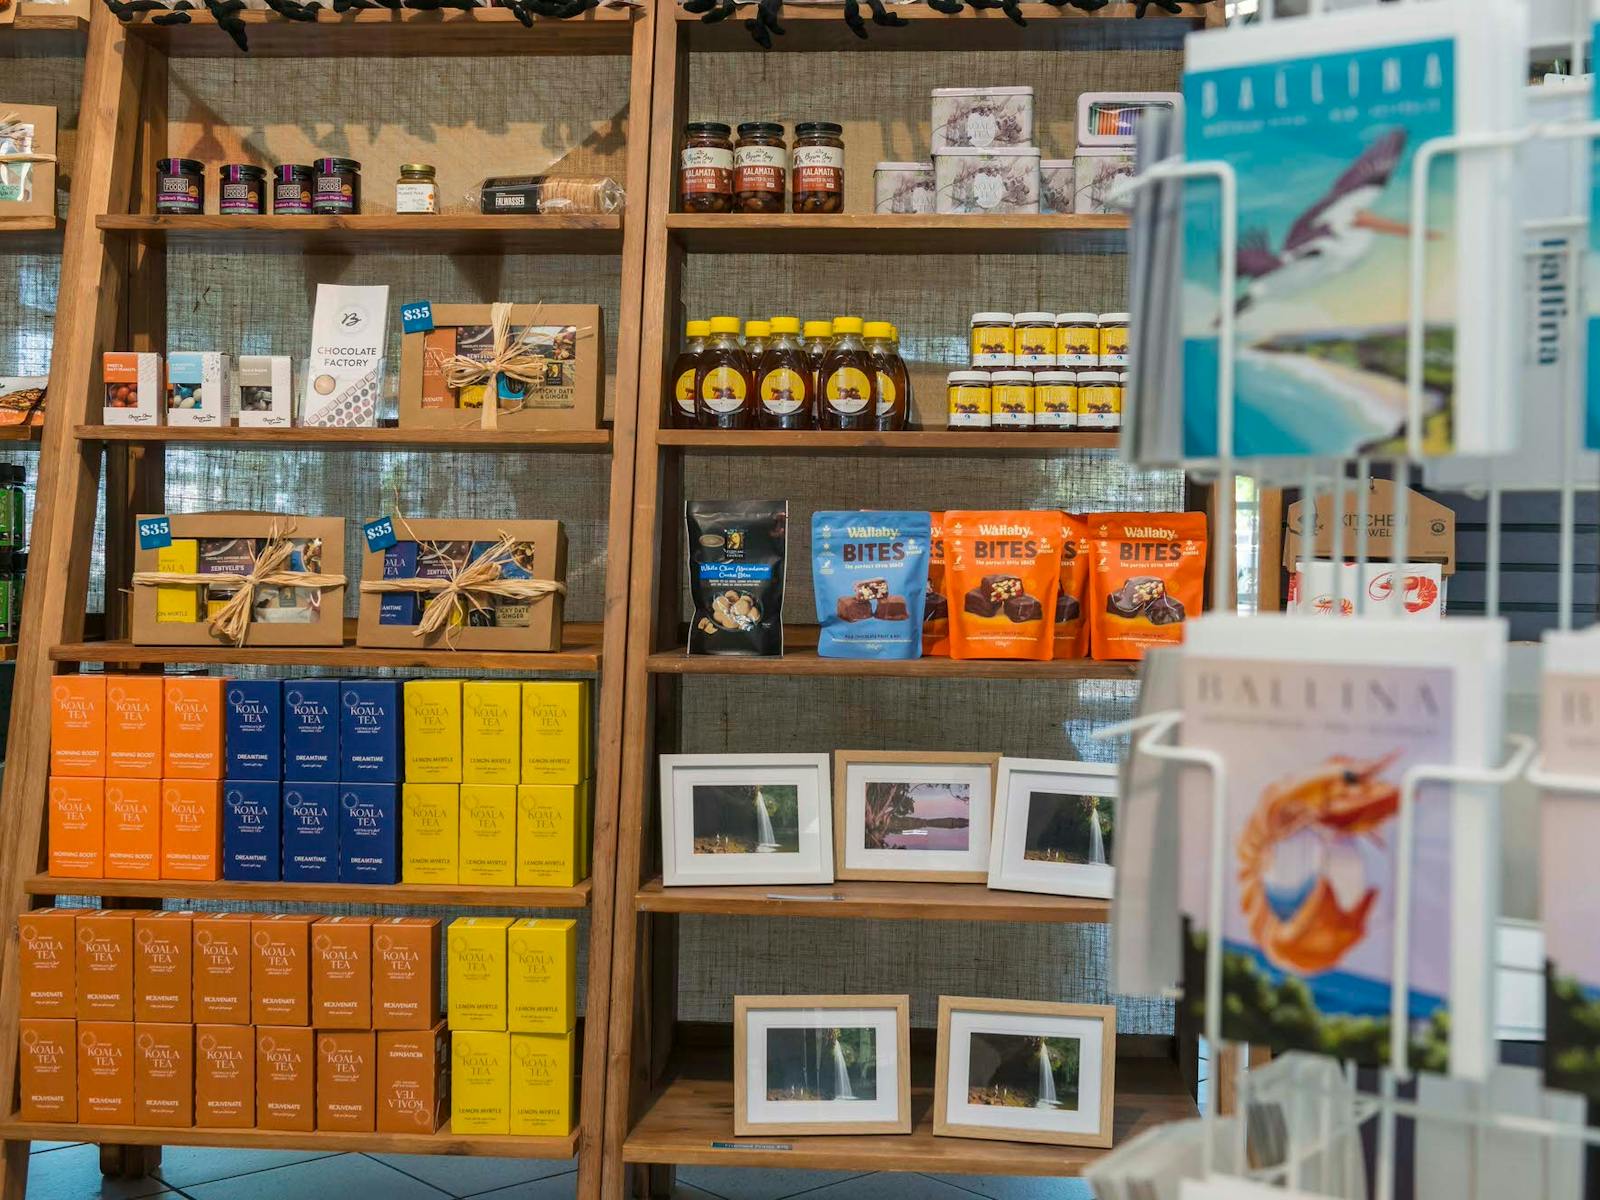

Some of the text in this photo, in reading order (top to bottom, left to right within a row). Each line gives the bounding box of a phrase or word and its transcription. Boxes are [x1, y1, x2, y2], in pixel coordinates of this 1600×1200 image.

[686, 168, 716, 176] KALAMATA
[743, 168, 774, 176] KALAMATA
[802, 168, 834, 176] KALAMATA
[496, 197, 524, 206] FALWASSER
[404, 306, 430, 320] $35
[317, 347, 377, 356] CHOCOLATE
[324, 359, 368, 367] FACTORY
[140, 522, 169, 536] $35
[367, 522, 392, 540] $35
[848, 526, 898, 540] Wallaby
[979, 524, 1030, 538] Wallaby
[1124, 527, 1176, 540] Wallaby
[843, 543, 904, 562] BITES
[975, 541, 1037, 558] BITES
[1120, 543, 1181, 560] BITES
[60, 702, 94, 710] KOALA
[116, 703, 150, 712] KOALA
[175, 704, 208, 712] KOALA
[236, 705, 269, 713] KOALA
[294, 706, 328, 715] KOALA
[350, 706, 384, 715] KOALA
[68, 711, 87, 719] TEA
[123, 712, 142, 720] TEA
[415, 707, 449, 716] KOALA
[474, 708, 507, 718] KOALA
[533, 709, 567, 717] KOALA
[182, 713, 201, 721] TEA
[302, 715, 321, 723] TEA
[358, 716, 377, 724] TEA
[424, 717, 442, 725] TEA
[482, 718, 500, 726] TEA
[541, 718, 560, 726] TEA
[58, 803, 92, 812] KOALA
[115, 804, 147, 813] KOALA
[172, 805, 205, 814] KOALA
[234, 806, 268, 815] KOALA
[293, 807, 327, 816] KOALA
[66, 812, 85, 820] TEA
[350, 809, 383, 818] KOALA
[413, 808, 447, 818] KOALA
[471, 810, 504, 819] KOALA
[528, 811, 561, 819] KOALA
[122, 814, 140, 822] TEA
[178, 814, 197, 823] TEA
[242, 815, 261, 823] TEA
[301, 816, 320, 825] TEA
[357, 818, 376, 826] TEA
[422, 818, 439, 826] TEA
[479, 820, 496, 828] TEA
[536, 821, 554, 829] TEA
[29, 941, 63, 950] KOALA
[86, 944, 120, 952] KOALA
[145, 945, 179, 954] KOALA
[36, 951, 56, 959] TEA
[204, 946, 238, 955] KOALA
[262, 947, 296, 956] KOALA
[94, 953, 113, 961] TEA
[152, 954, 172, 963] TEA
[211, 956, 231, 964] TEA
[322, 951, 358, 960] KOALA
[383, 952, 419, 961] KOALA
[459, 953, 494, 962] KOALA
[519, 955, 554, 964] KOALA
[269, 957, 288, 965] TEA
[330, 961, 350, 969] TEA
[391, 962, 411, 970] TEA
[467, 962, 487, 971] TEA
[527, 965, 547, 973] TEA
[30, 1046, 64, 1054] KOALA
[88, 1048, 122, 1057] KOALA
[145, 1050, 180, 1059] KOALA
[37, 1055, 56, 1063] TEA
[207, 1051, 243, 1060] KOALA
[267, 1053, 301, 1062] KOALA
[328, 1054, 363, 1064] KOALA
[95, 1057, 114, 1066] TEA
[152, 1059, 172, 1068] TEA
[215, 1060, 235, 1069] TEA
[463, 1057, 498, 1066] KOALA
[521, 1058, 557, 1067] KOALA
[274, 1062, 293, 1071] TEA
[336, 1064, 355, 1072] TEA
[471, 1067, 490, 1075] TEA
[529, 1068, 550, 1077] TEA
[396, 1090, 415, 1099] TEA
[388, 1099, 423, 1109] KOALA
